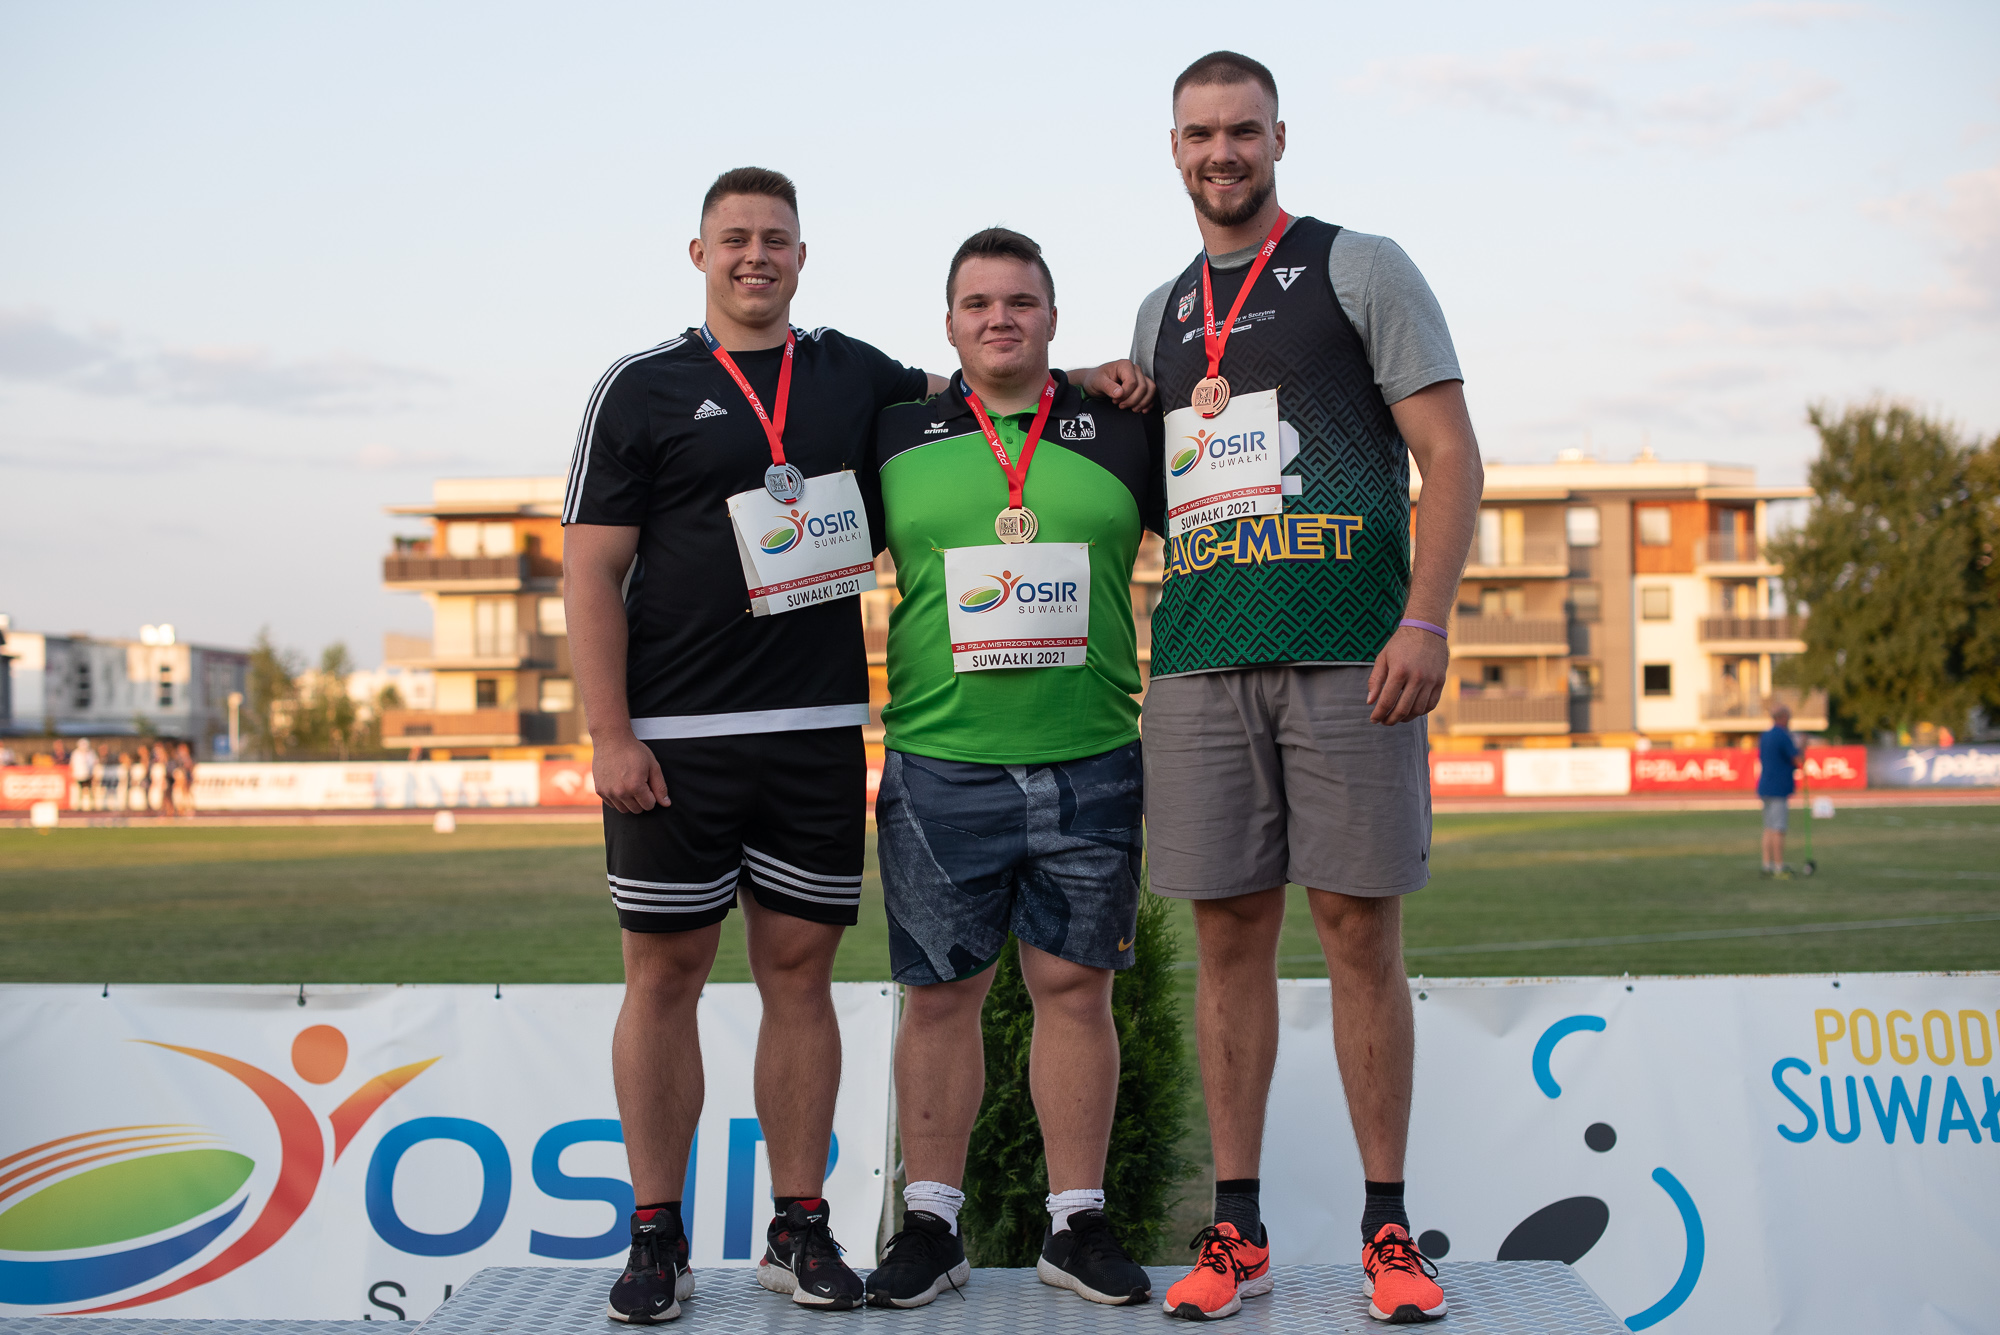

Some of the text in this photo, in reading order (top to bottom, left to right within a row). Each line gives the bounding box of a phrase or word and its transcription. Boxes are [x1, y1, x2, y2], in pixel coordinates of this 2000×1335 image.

[1262, 240, 1277, 257] MCC
[1206, 309, 1214, 335] PZLA
[694, 409, 728, 420] adidas
[749, 392, 767, 420] PZLA
[1063, 429, 1076, 437] AZS
[992, 438, 1009, 466] PZLA
[1209, 431, 1267, 458] OSIR
[1211, 453, 1267, 470] SUWAŁKI
[1190, 493, 1231, 508] MISTRZOSTWA
[1232, 489, 1258, 498] POLSKI
[807, 510, 859, 537] OSIR
[1181, 500, 1257, 530] SUWAŁKI 2021
[814, 531, 861, 548] SUWAŁKI
[797, 572, 838, 587] MISTRZOSTWA
[838, 567, 858, 577] POLSKI
[859, 564, 871, 572] U23
[787, 579, 860, 607] SUWAŁKI 2021
[1016, 582, 1077, 603] OSIR
[1018, 605, 1078, 614] SUWAŁKI
[972, 652, 1066, 668] SUWAŁKI 2021
